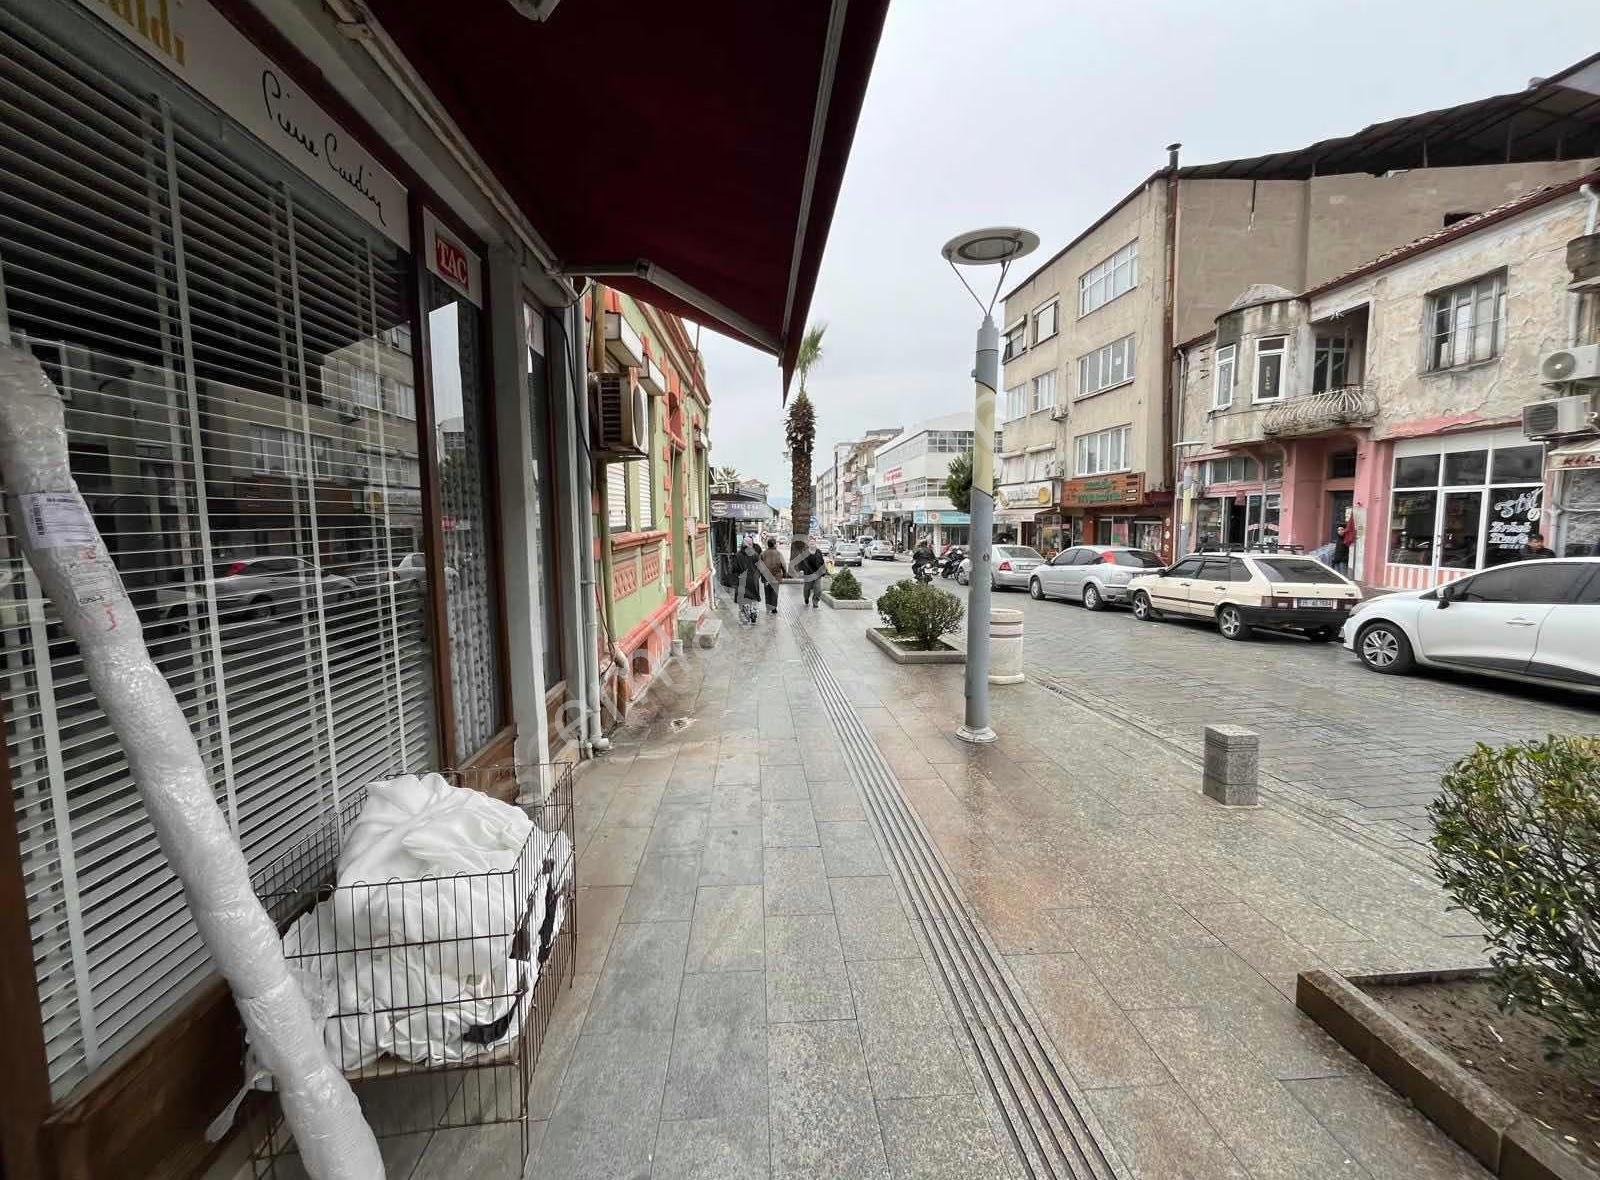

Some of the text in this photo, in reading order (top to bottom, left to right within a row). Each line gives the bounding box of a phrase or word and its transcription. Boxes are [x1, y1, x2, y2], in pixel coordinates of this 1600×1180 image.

[262, 70, 387, 227] Pierre Cardin
[436, 238, 468, 285] TAC
